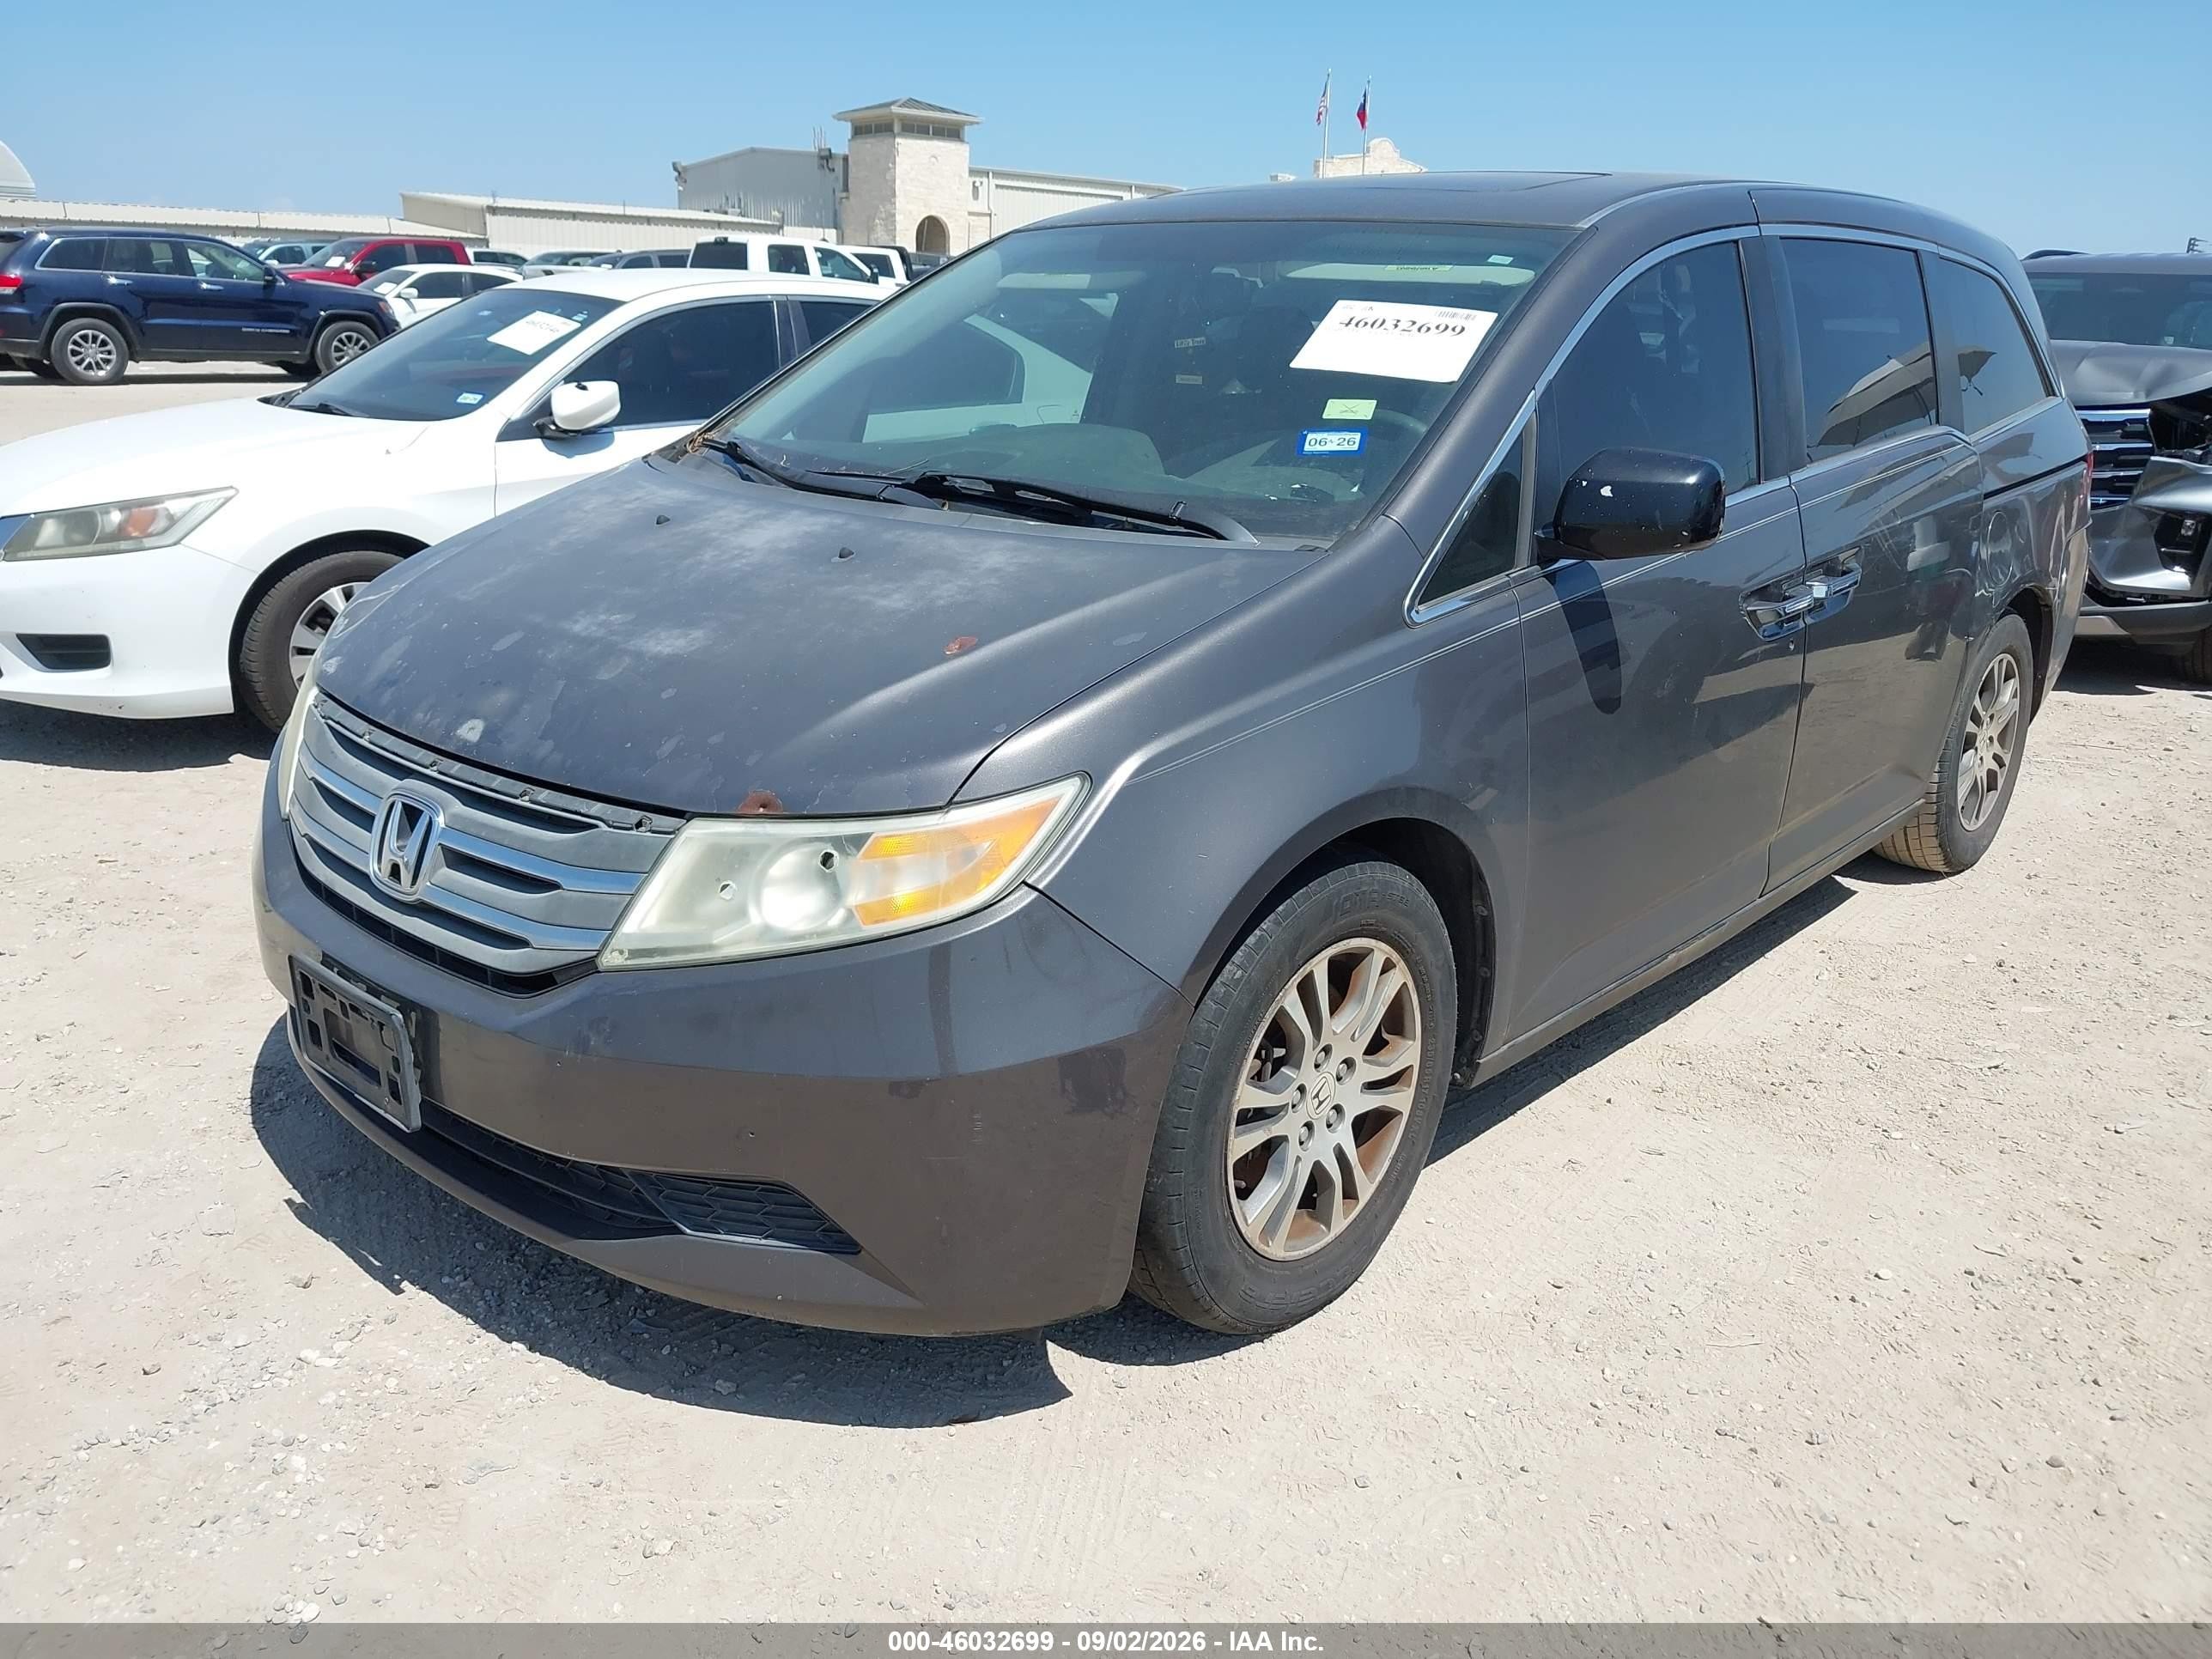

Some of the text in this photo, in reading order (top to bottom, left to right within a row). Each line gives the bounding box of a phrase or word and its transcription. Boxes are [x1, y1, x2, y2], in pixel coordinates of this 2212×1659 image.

[1339, 315, 1467, 337] 46032699
[1308, 436, 1358, 447] 06 26
